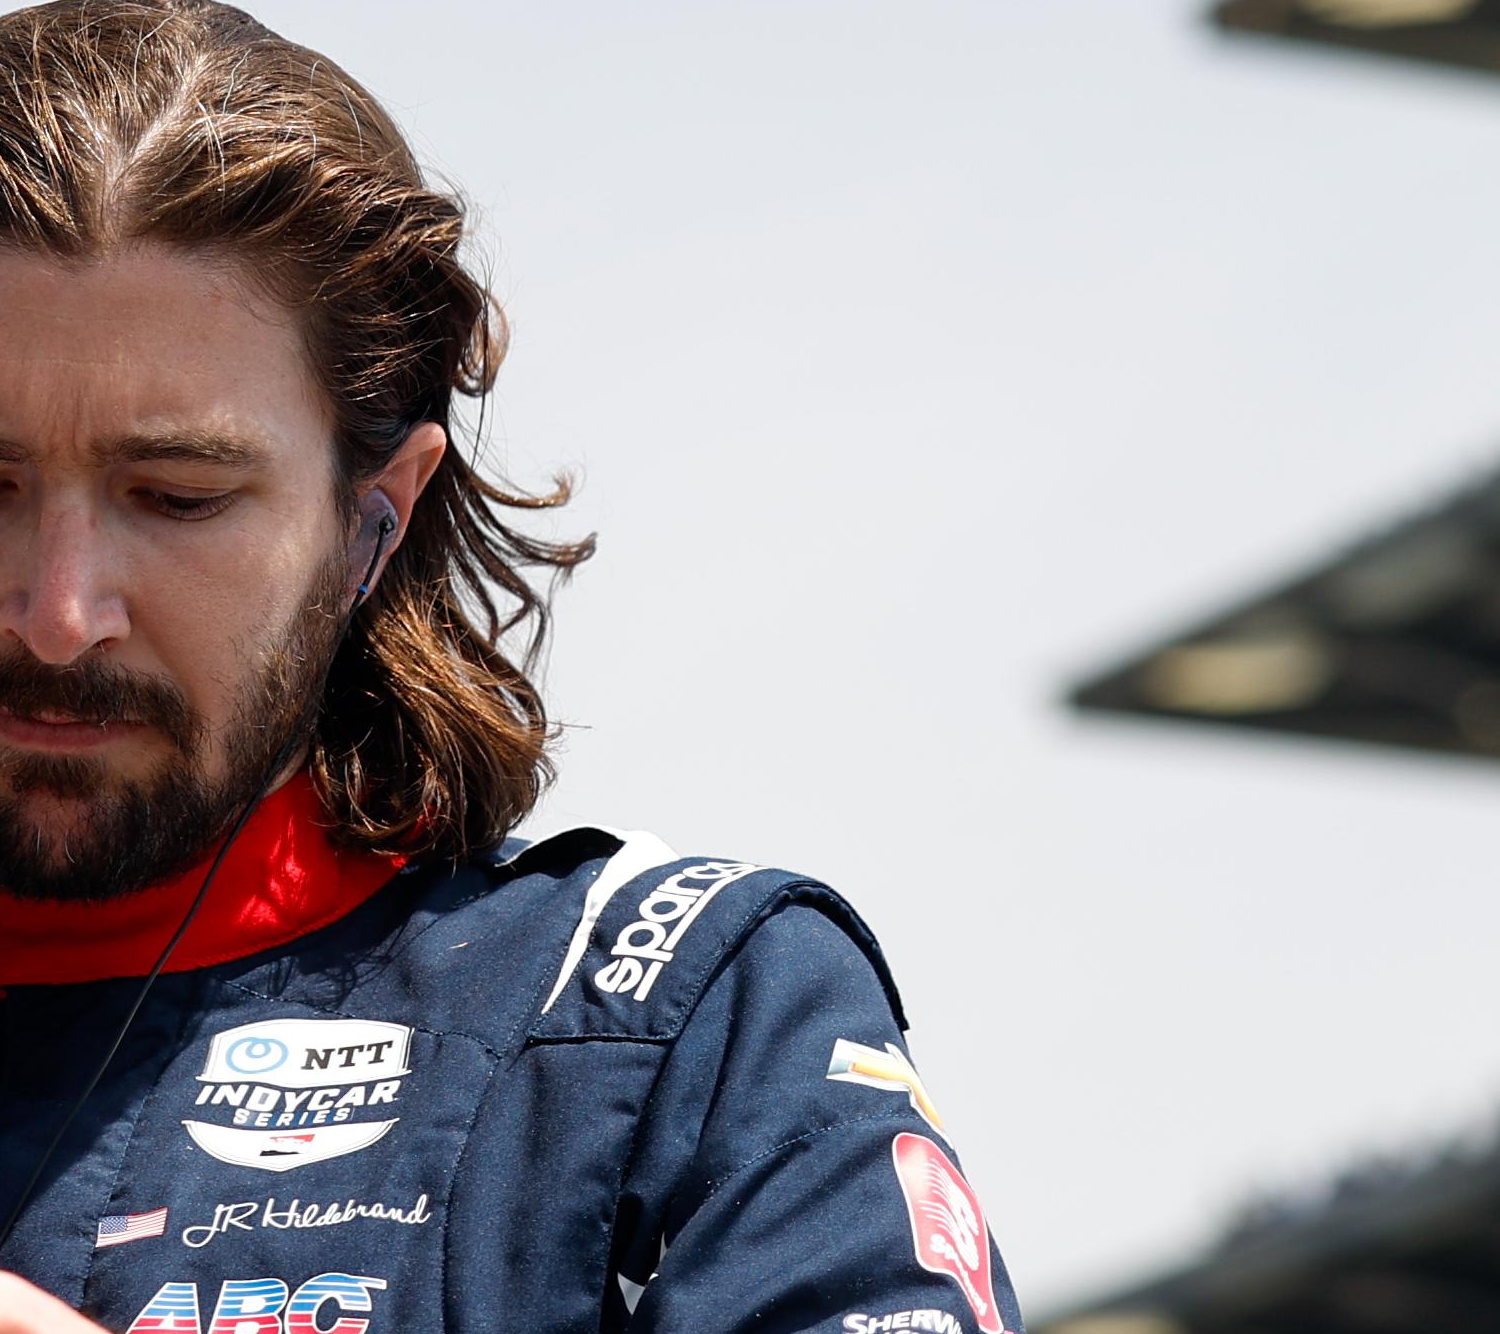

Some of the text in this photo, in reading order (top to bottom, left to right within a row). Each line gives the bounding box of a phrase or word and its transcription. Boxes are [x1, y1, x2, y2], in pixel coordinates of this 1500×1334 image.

[301, 1040, 393, 1070] NTT
[195, 1079, 401, 1112] INDYCAR
[233, 1107, 351, 1127] SERIES
[183, 1194, 431, 1248] JR Hildebrand
